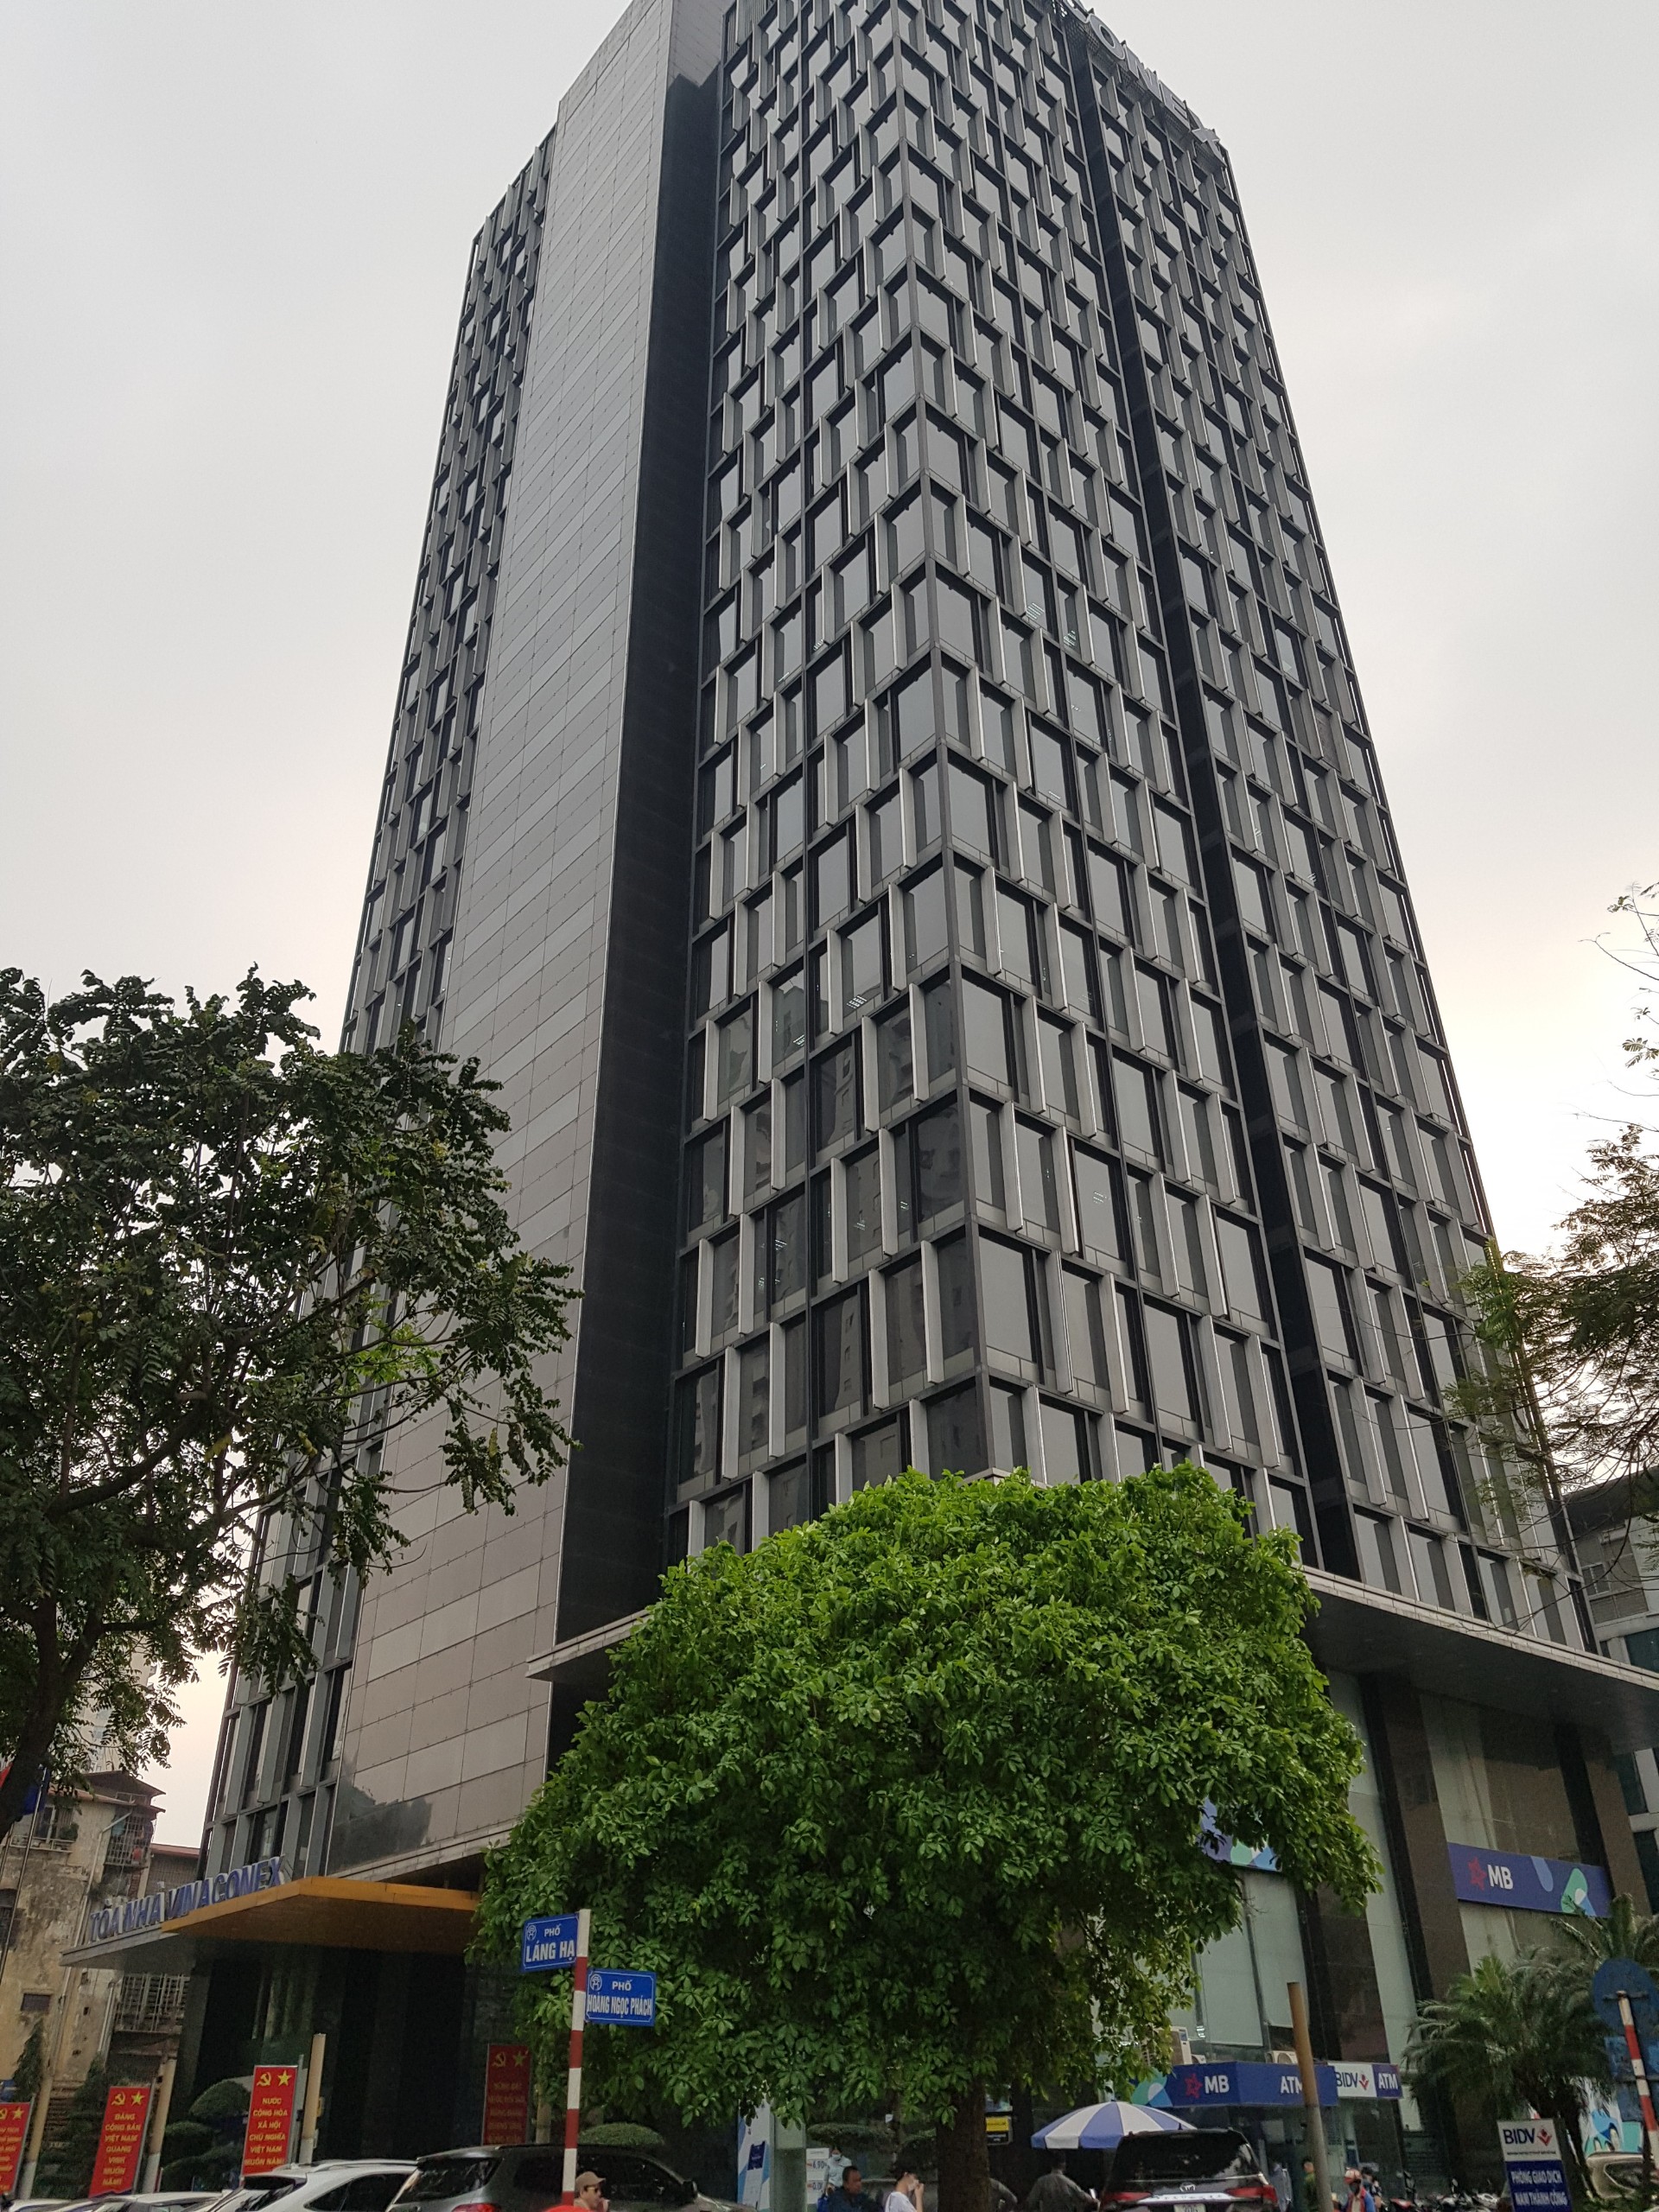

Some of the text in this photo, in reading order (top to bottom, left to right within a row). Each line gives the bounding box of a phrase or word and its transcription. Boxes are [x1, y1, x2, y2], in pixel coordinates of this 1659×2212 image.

[1487, 1864, 1514, 1890] MB
[165, 1856, 284, 1920] VINACONEX
[543, 1923, 562, 1937] PHỐ
[525, 1940, 575, 1963] LÁNG HẠ
[612, 1979, 632, 1992] PHỐ
[587, 1993, 652, 2018] HOÀNG NGỌC PHÁCH
[1204, 2075, 1230, 2094] MB
[1336, 2072, 1358, 2088] BIDV
[1377, 2073, 1399, 2090] ATM
[1503, 2128, 1535, 2145] BIDV
